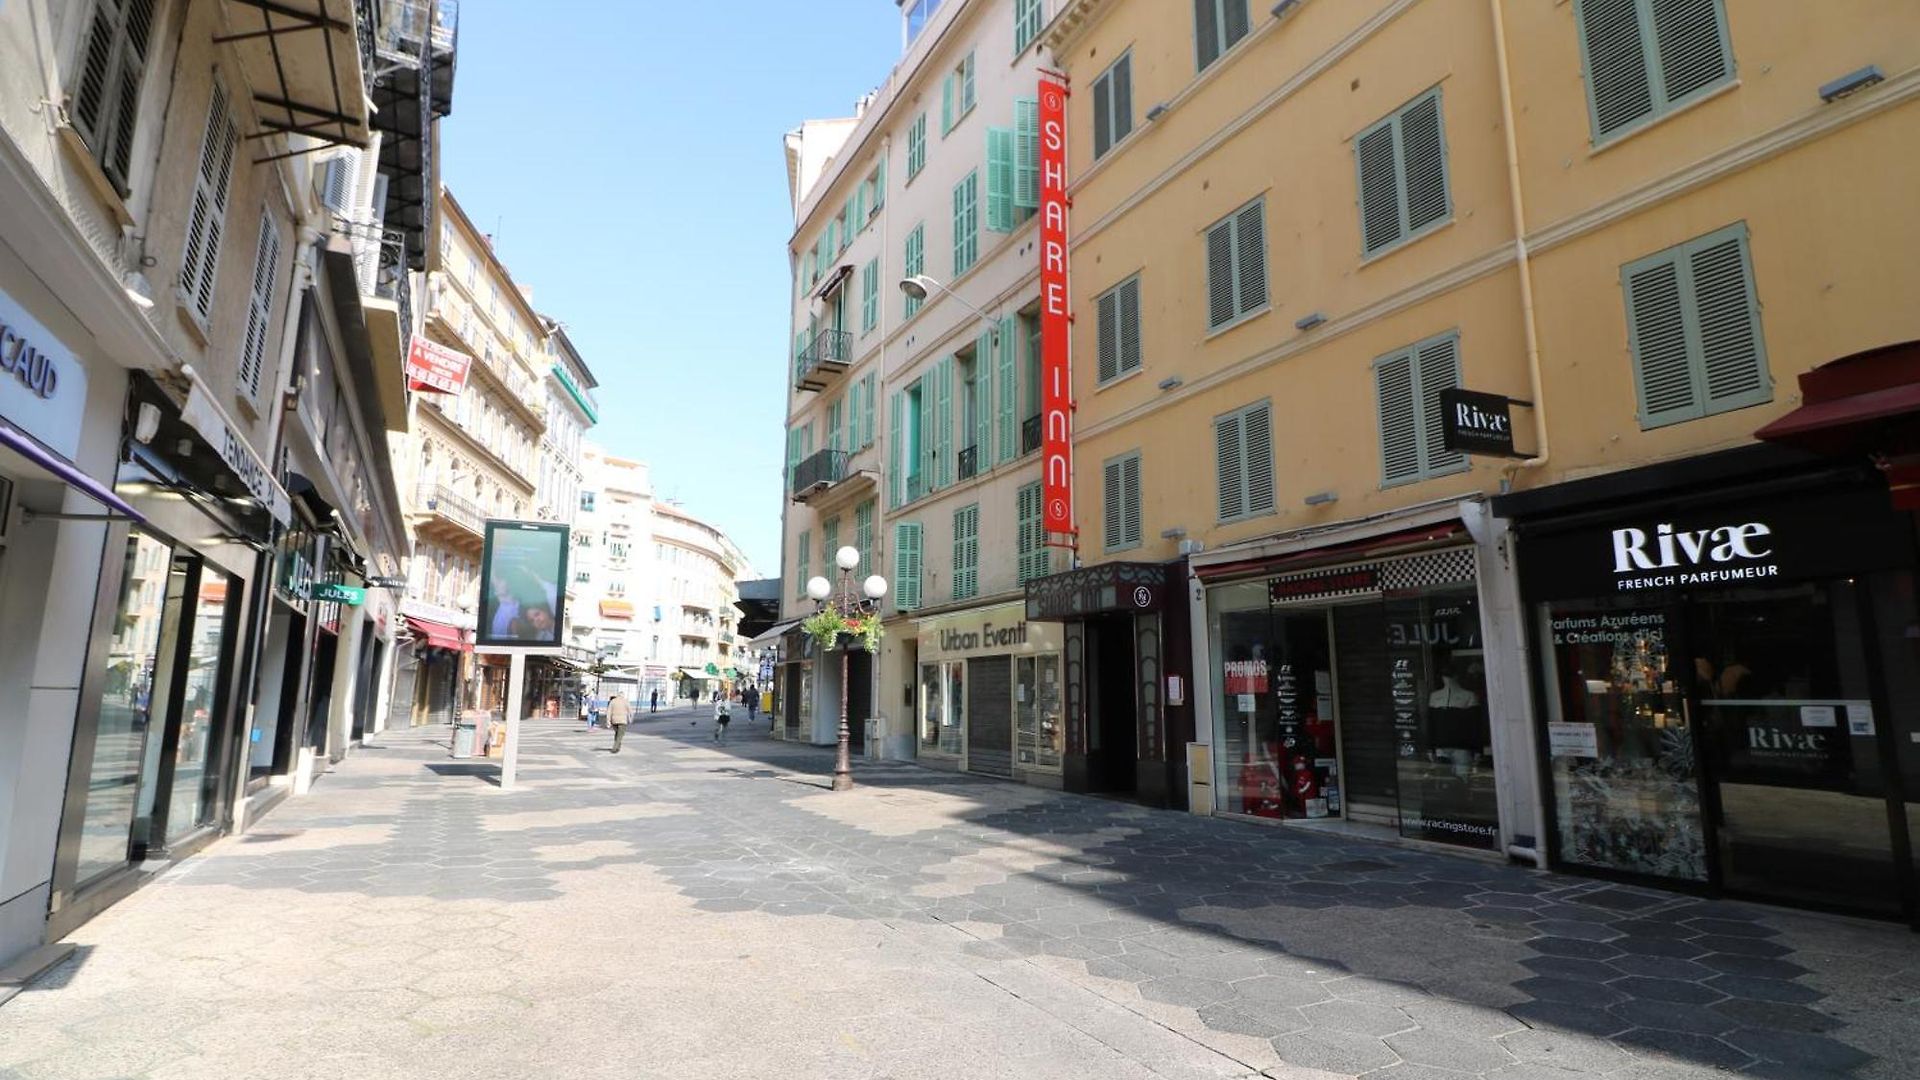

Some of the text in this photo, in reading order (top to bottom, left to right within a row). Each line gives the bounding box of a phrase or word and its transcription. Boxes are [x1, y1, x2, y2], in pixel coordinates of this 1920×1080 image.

[1044, 120, 1064, 315] SHARE
[1617, 565, 1779, 590] FRENCH PARFUMEUR
[319, 587, 359, 601] JULES
[1600, 612, 1665, 628] Azuréens
[941, 628, 978, 651] Urban
[1224, 660, 1267, 678] PROMOS
[1402, 817, 1498, 836] www.racingstore.fr
